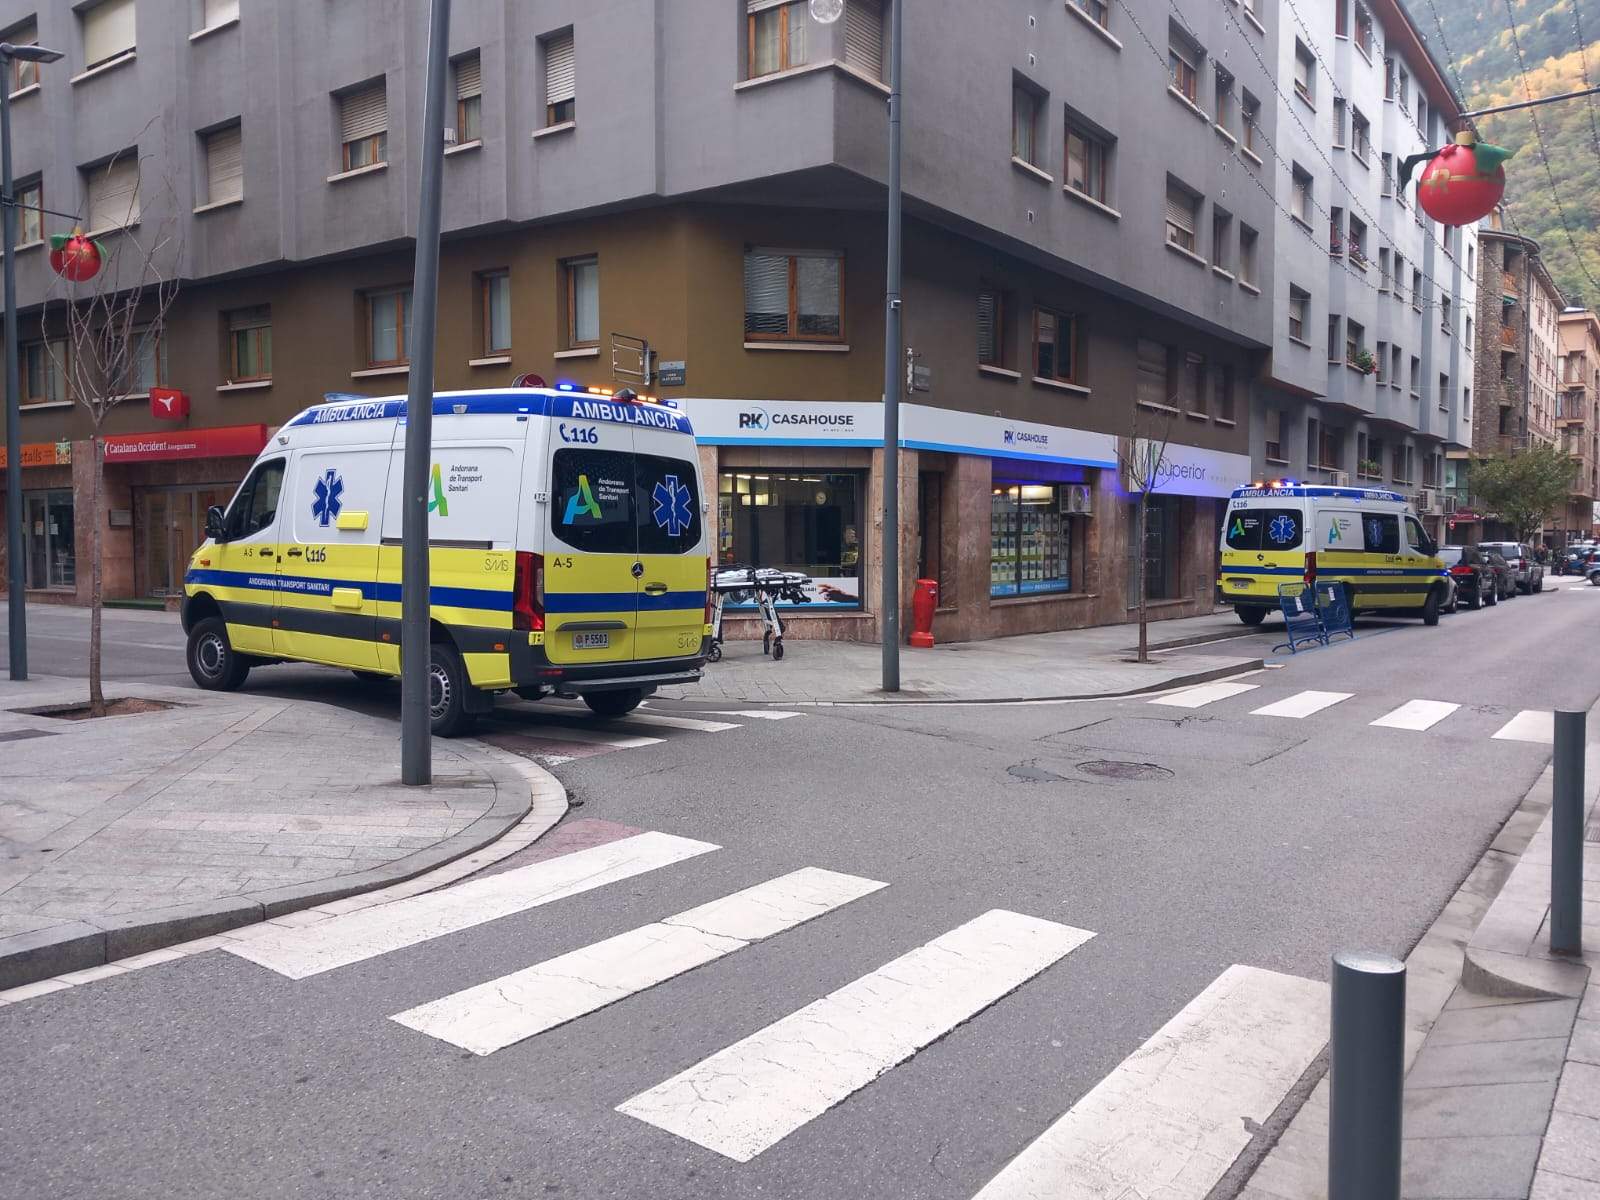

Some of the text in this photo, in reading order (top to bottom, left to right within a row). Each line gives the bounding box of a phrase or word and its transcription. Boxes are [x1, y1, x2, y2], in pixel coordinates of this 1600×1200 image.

[739, 413, 854, 428] RK CASAHOUSE
[570, 426, 599, 444] 116
[1016, 432, 1049, 444] CASAHOUSE
[110, 443, 137, 454] Catalana
[138, 441, 167, 451] Occident
[20, 448, 42, 464] etalls
[1157, 458, 1206, 480] Superior
[449, 474, 483, 483] de Transport
[448, 484, 468, 492] Sanitari
[606, 486, 629, 494] Transport
[598, 493, 618, 501] Sanitari
[310, 547, 326, 562] 116
[553, 557, 573, 568] A-5
[277, 579, 306, 590] TRANSPORT
[306, 582, 330, 592] SANITARI
